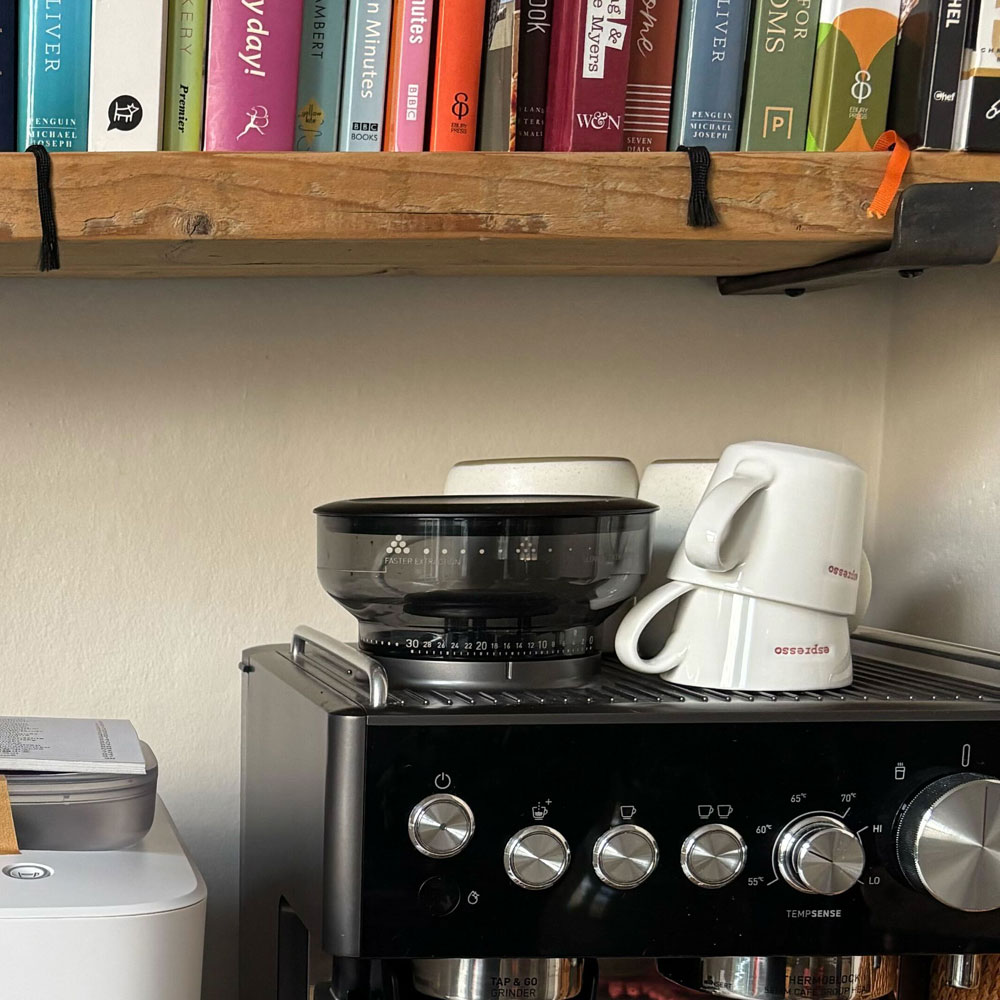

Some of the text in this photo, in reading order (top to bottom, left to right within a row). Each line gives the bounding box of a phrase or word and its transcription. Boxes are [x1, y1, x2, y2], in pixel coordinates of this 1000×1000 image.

[608, 27, 622, 44] &
[588, 15, 605, 73] Myers
[361, 19, 382, 99] Minutes
[406, 84, 420, 121] BBC
[177, 84, 189, 134] Premier
[691, 111, 733, 119] PENGUIN
[29, 117, 77, 125] ENGUIN
[576, 111, 622, 130] W&N
[772, 116, 785, 132] P
[352, 122, 379, 132] BBC
[690, 123, 733, 131] MICHAEL
[351, 133, 378, 142] BOOKS
[626, 136, 653, 144] SEVEN
[692, 131, 728, 139] JOSEPH
[385, 557, 413, 565] FASTER
[405, 638, 420, 649] 30
[422, 641, 432, 649] 28
[464, 642, 473, 650] 22
[475, 641, 488, 651] 20
[538, 640, 548, 650] 10
[774, 644, 830, 655] espresso
[872, 824, 883, 833] HI
[868, 876, 881, 886] LO
[786, 909, 842, 918] TEMPSENSE
[491, 977, 538, 986] TAP & GO
[491, 988, 536, 998] GRINDER
